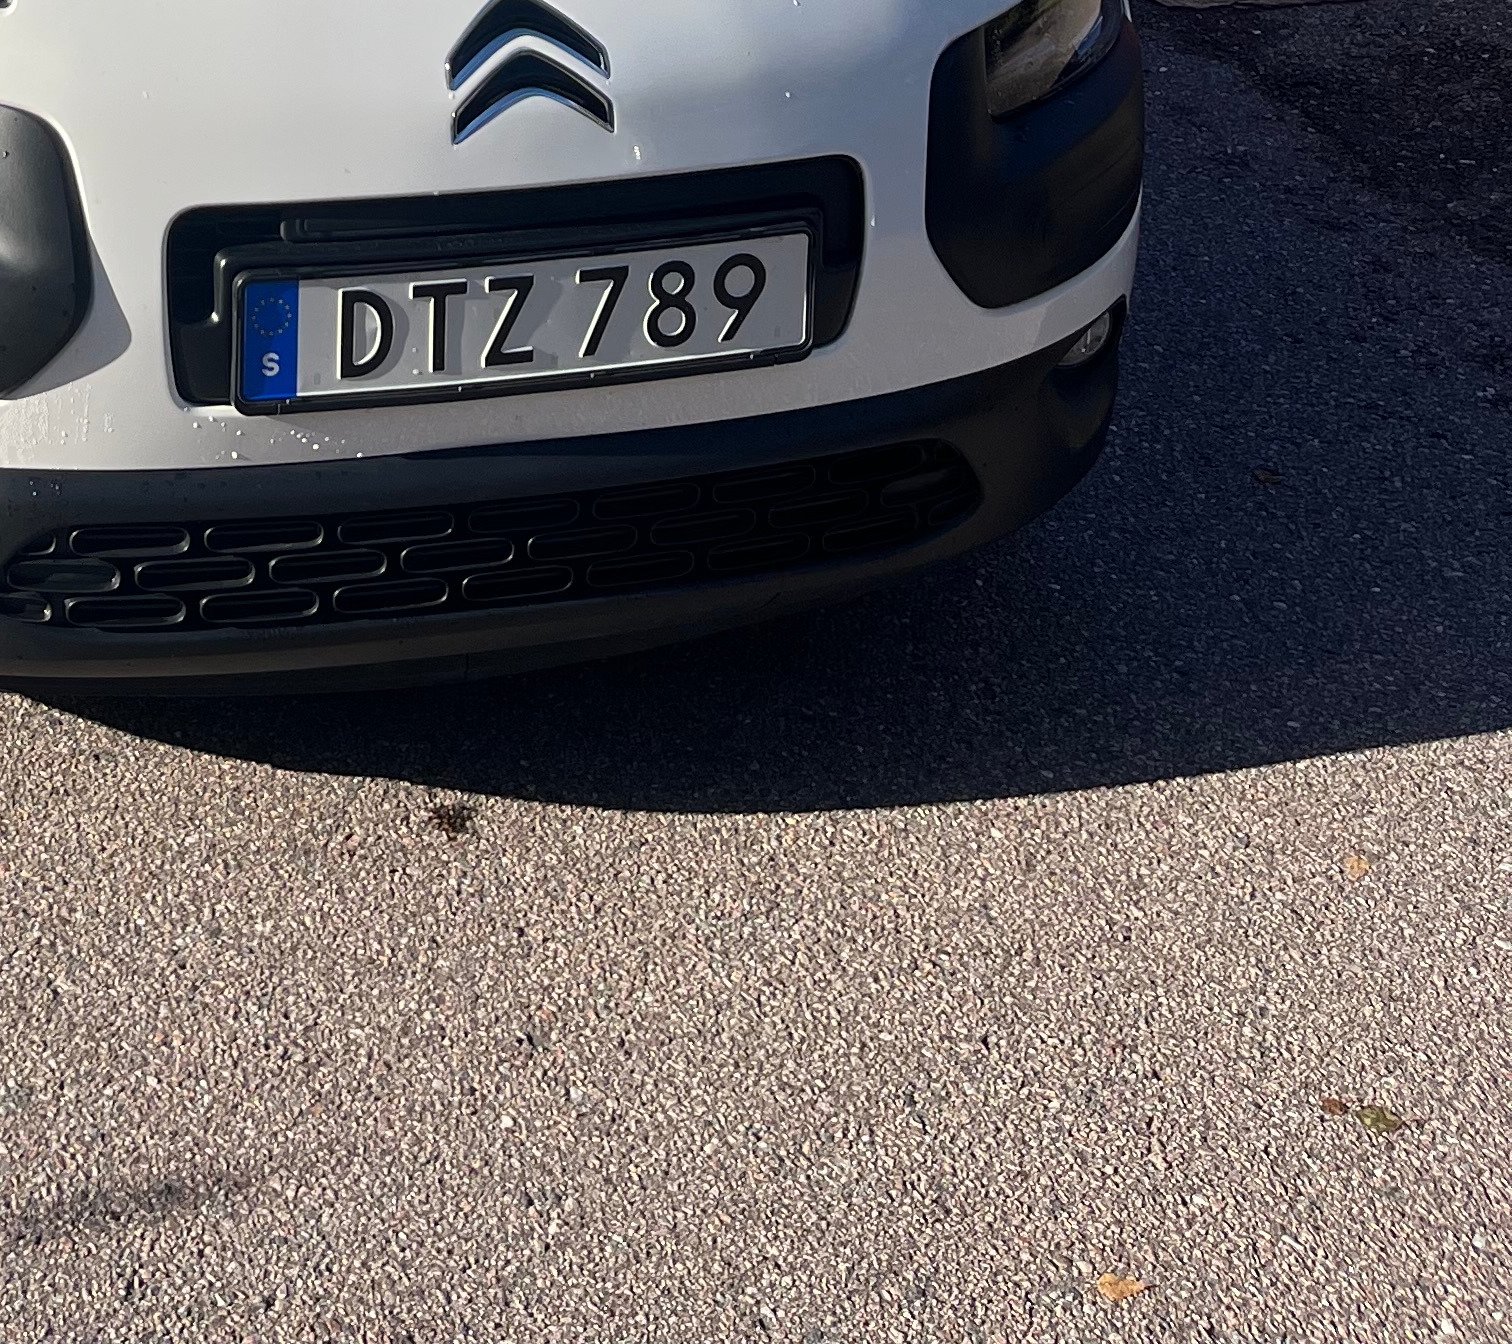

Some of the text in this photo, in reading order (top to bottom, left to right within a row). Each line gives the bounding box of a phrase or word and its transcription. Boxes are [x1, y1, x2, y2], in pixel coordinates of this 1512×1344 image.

[337, 253, 767, 380] DTZ 789
[262, 352, 280, 377] S
